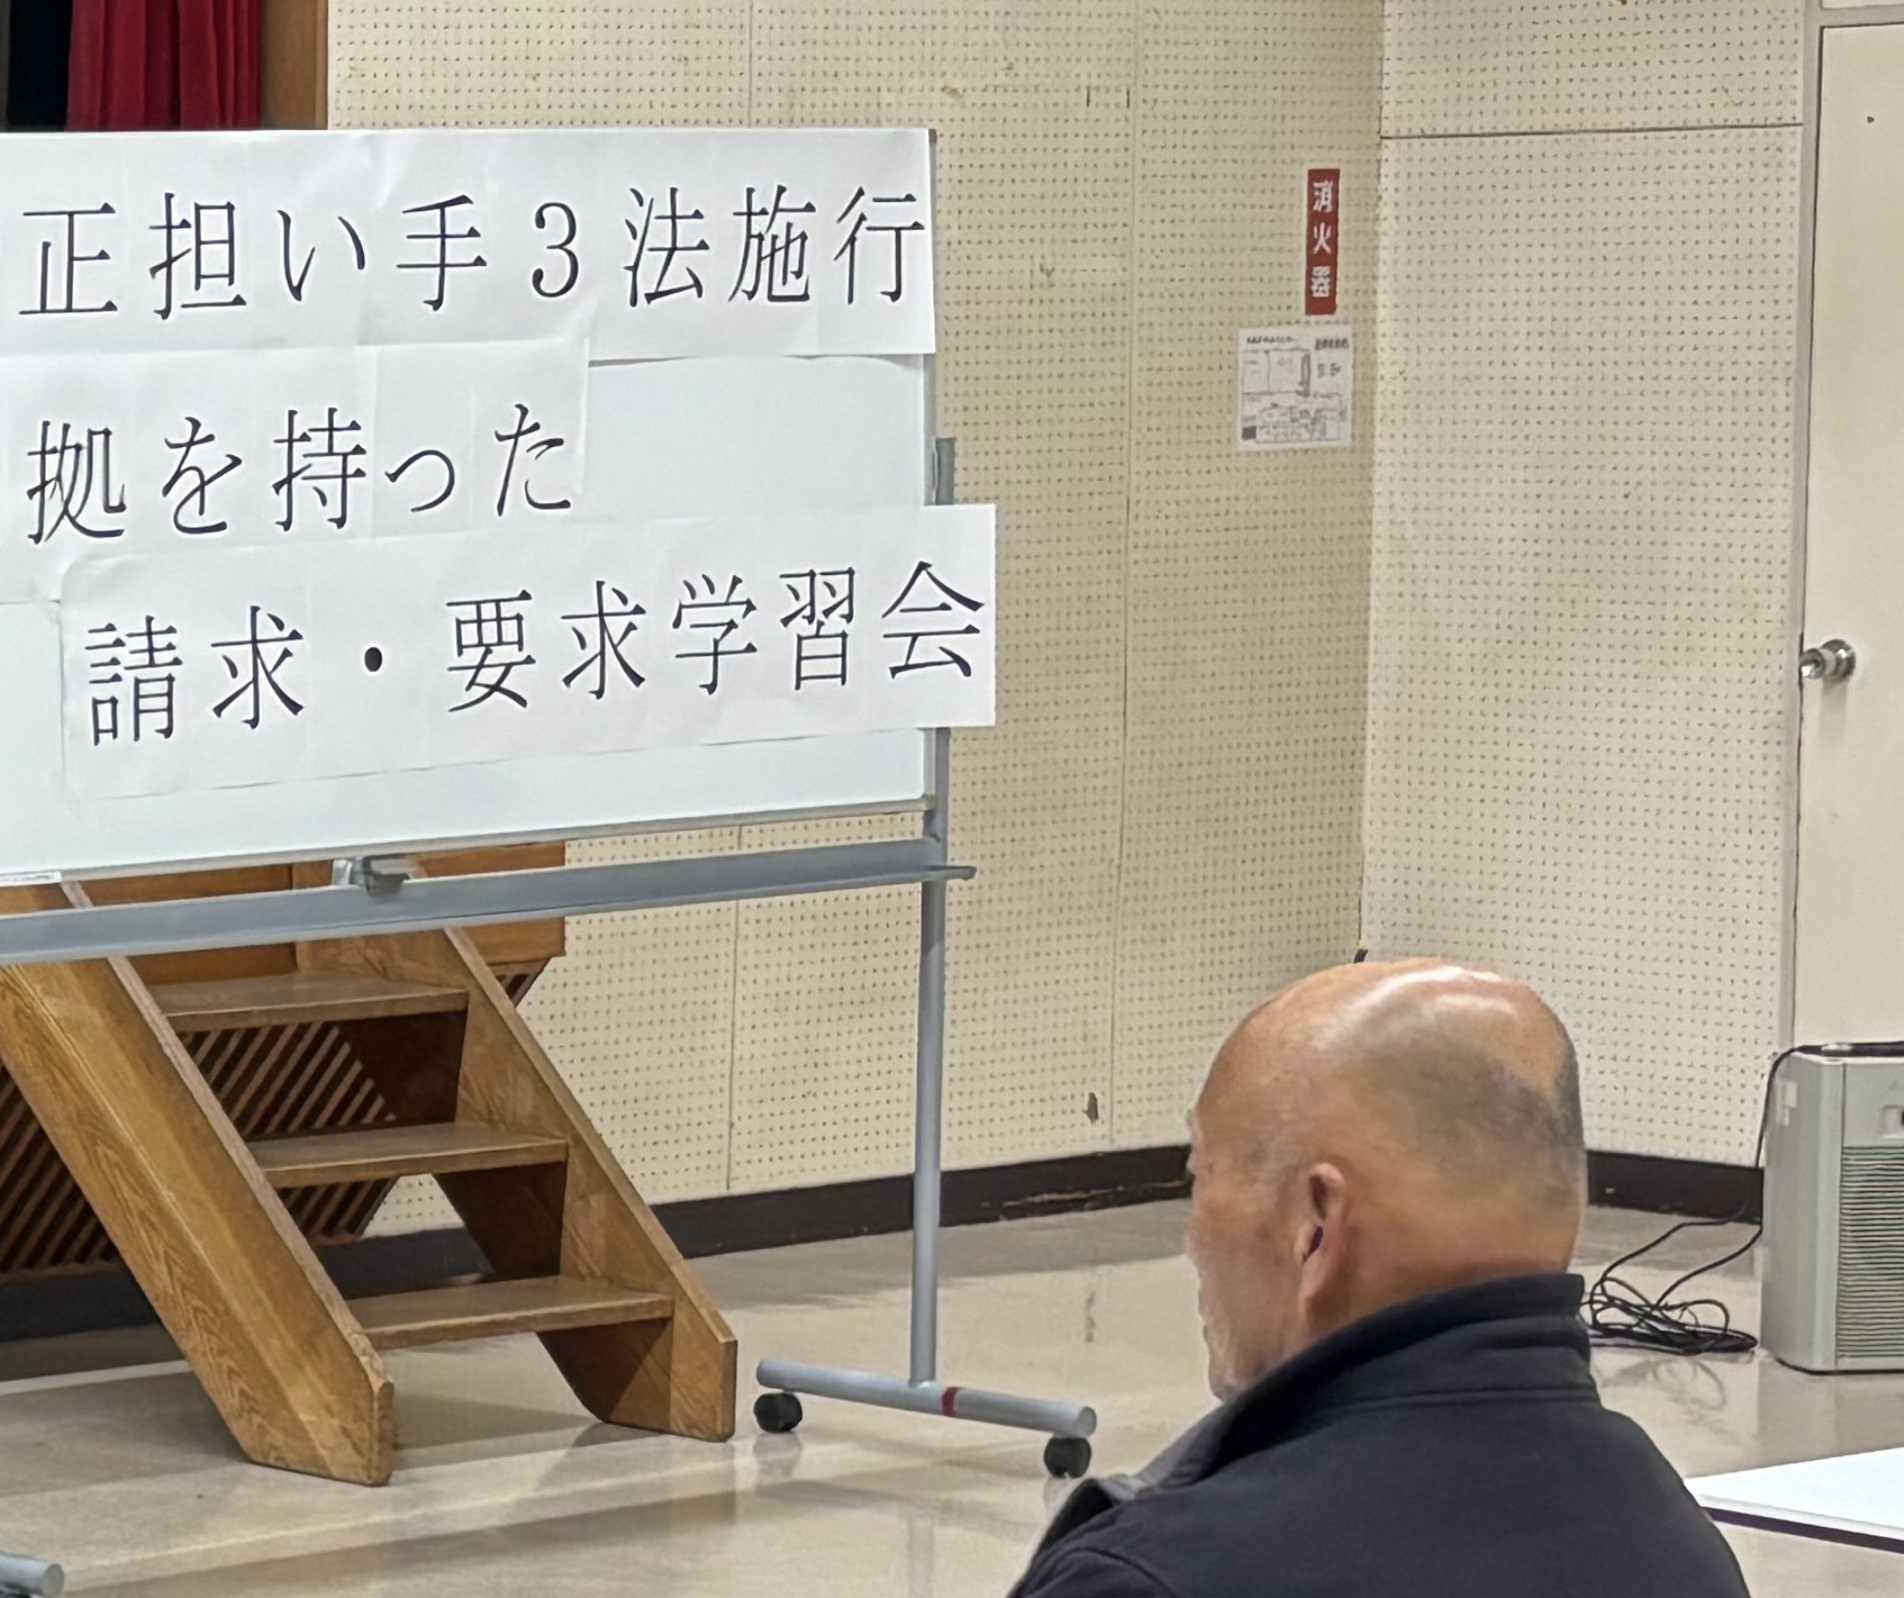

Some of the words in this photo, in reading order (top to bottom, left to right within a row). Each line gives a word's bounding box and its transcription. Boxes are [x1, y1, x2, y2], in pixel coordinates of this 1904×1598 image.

[85, 560, 984, 746] 請求・要求学習会
